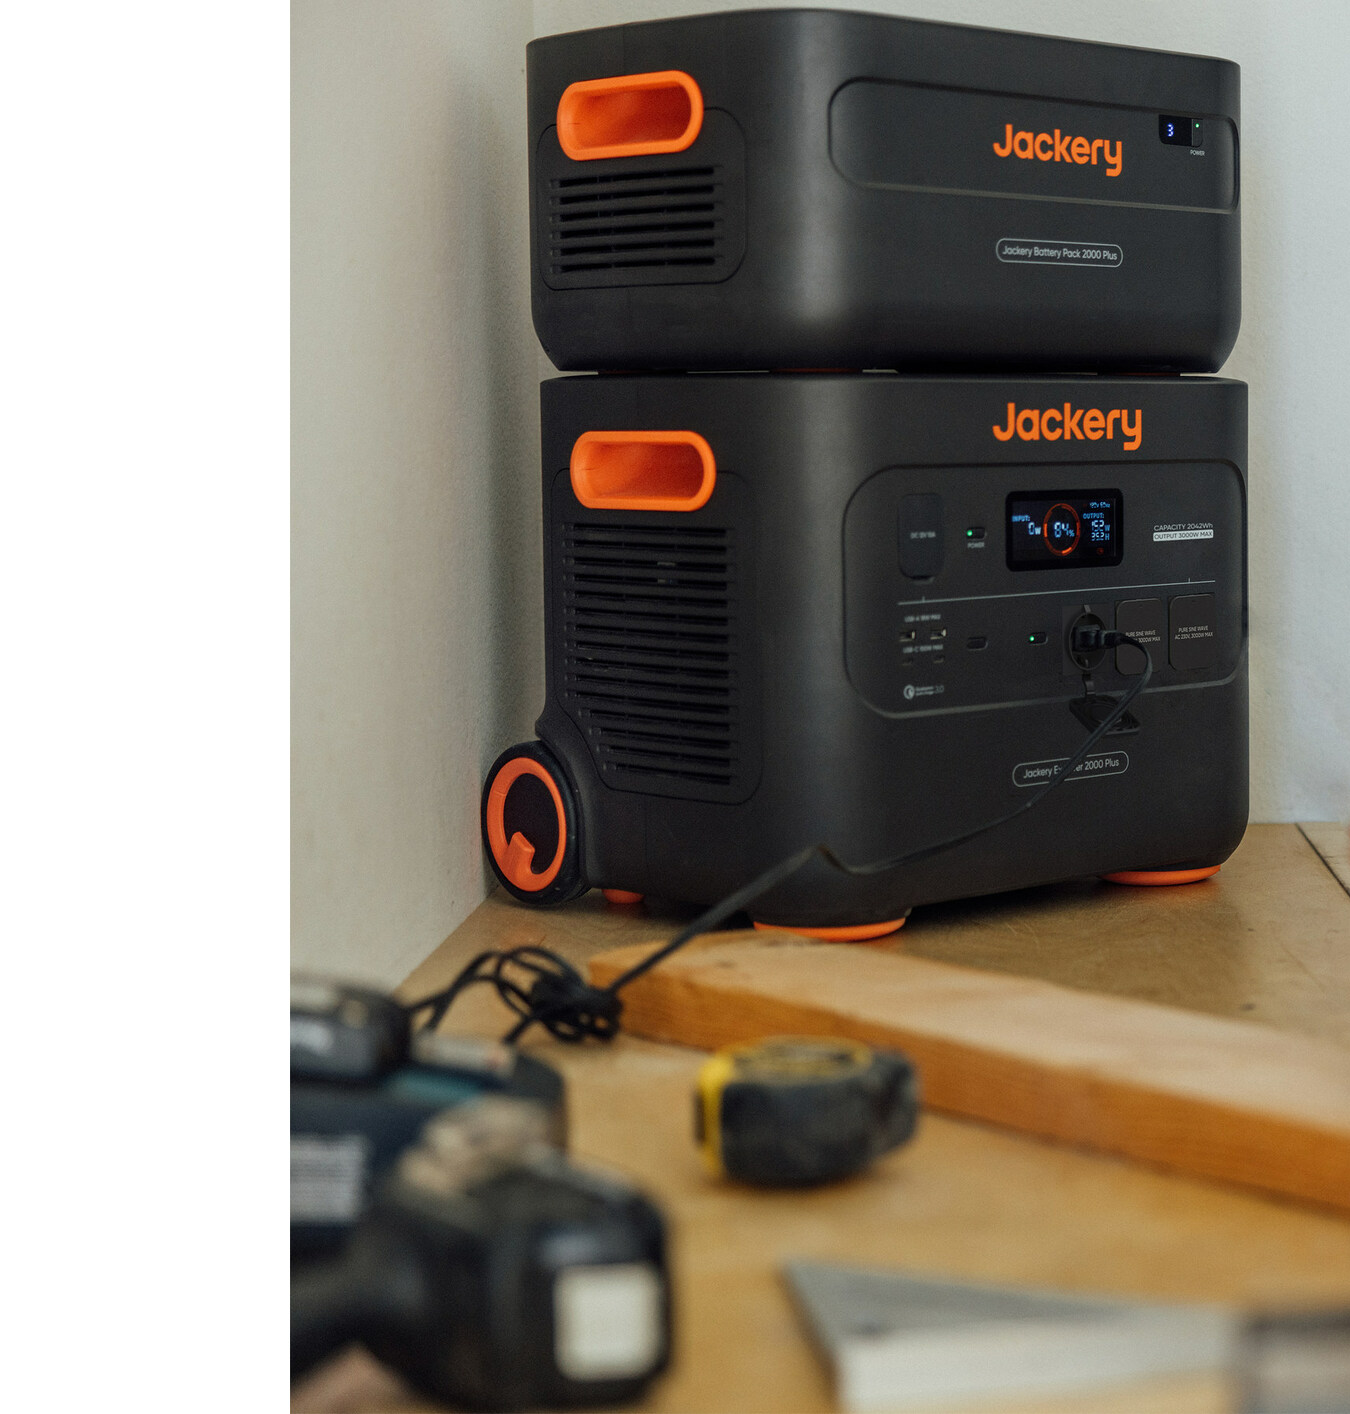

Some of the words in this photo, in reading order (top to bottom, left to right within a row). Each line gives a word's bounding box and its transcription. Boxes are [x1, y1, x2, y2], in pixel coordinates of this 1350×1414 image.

[1167, 123, 1174, 137] 3
[993, 124, 1123, 177] Jackery
[1002, 245, 1032, 257] Jackery
[1034, 247, 1061, 259] Battery
[1063, 248, 1081, 258] Pack
[1082, 249, 1101, 260] 2000
[1103, 250, 1118, 260] Plus
[992, 402, 1142, 451] Jackery
[1153, 523, 1186, 531] CAPACITY
[1187, 522, 1213, 530] 2042Wh
[1023, 766, 1052, 779] Jackery
[1085, 759, 1104, 770] 2000
[1105, 758, 1119, 767] Plus
